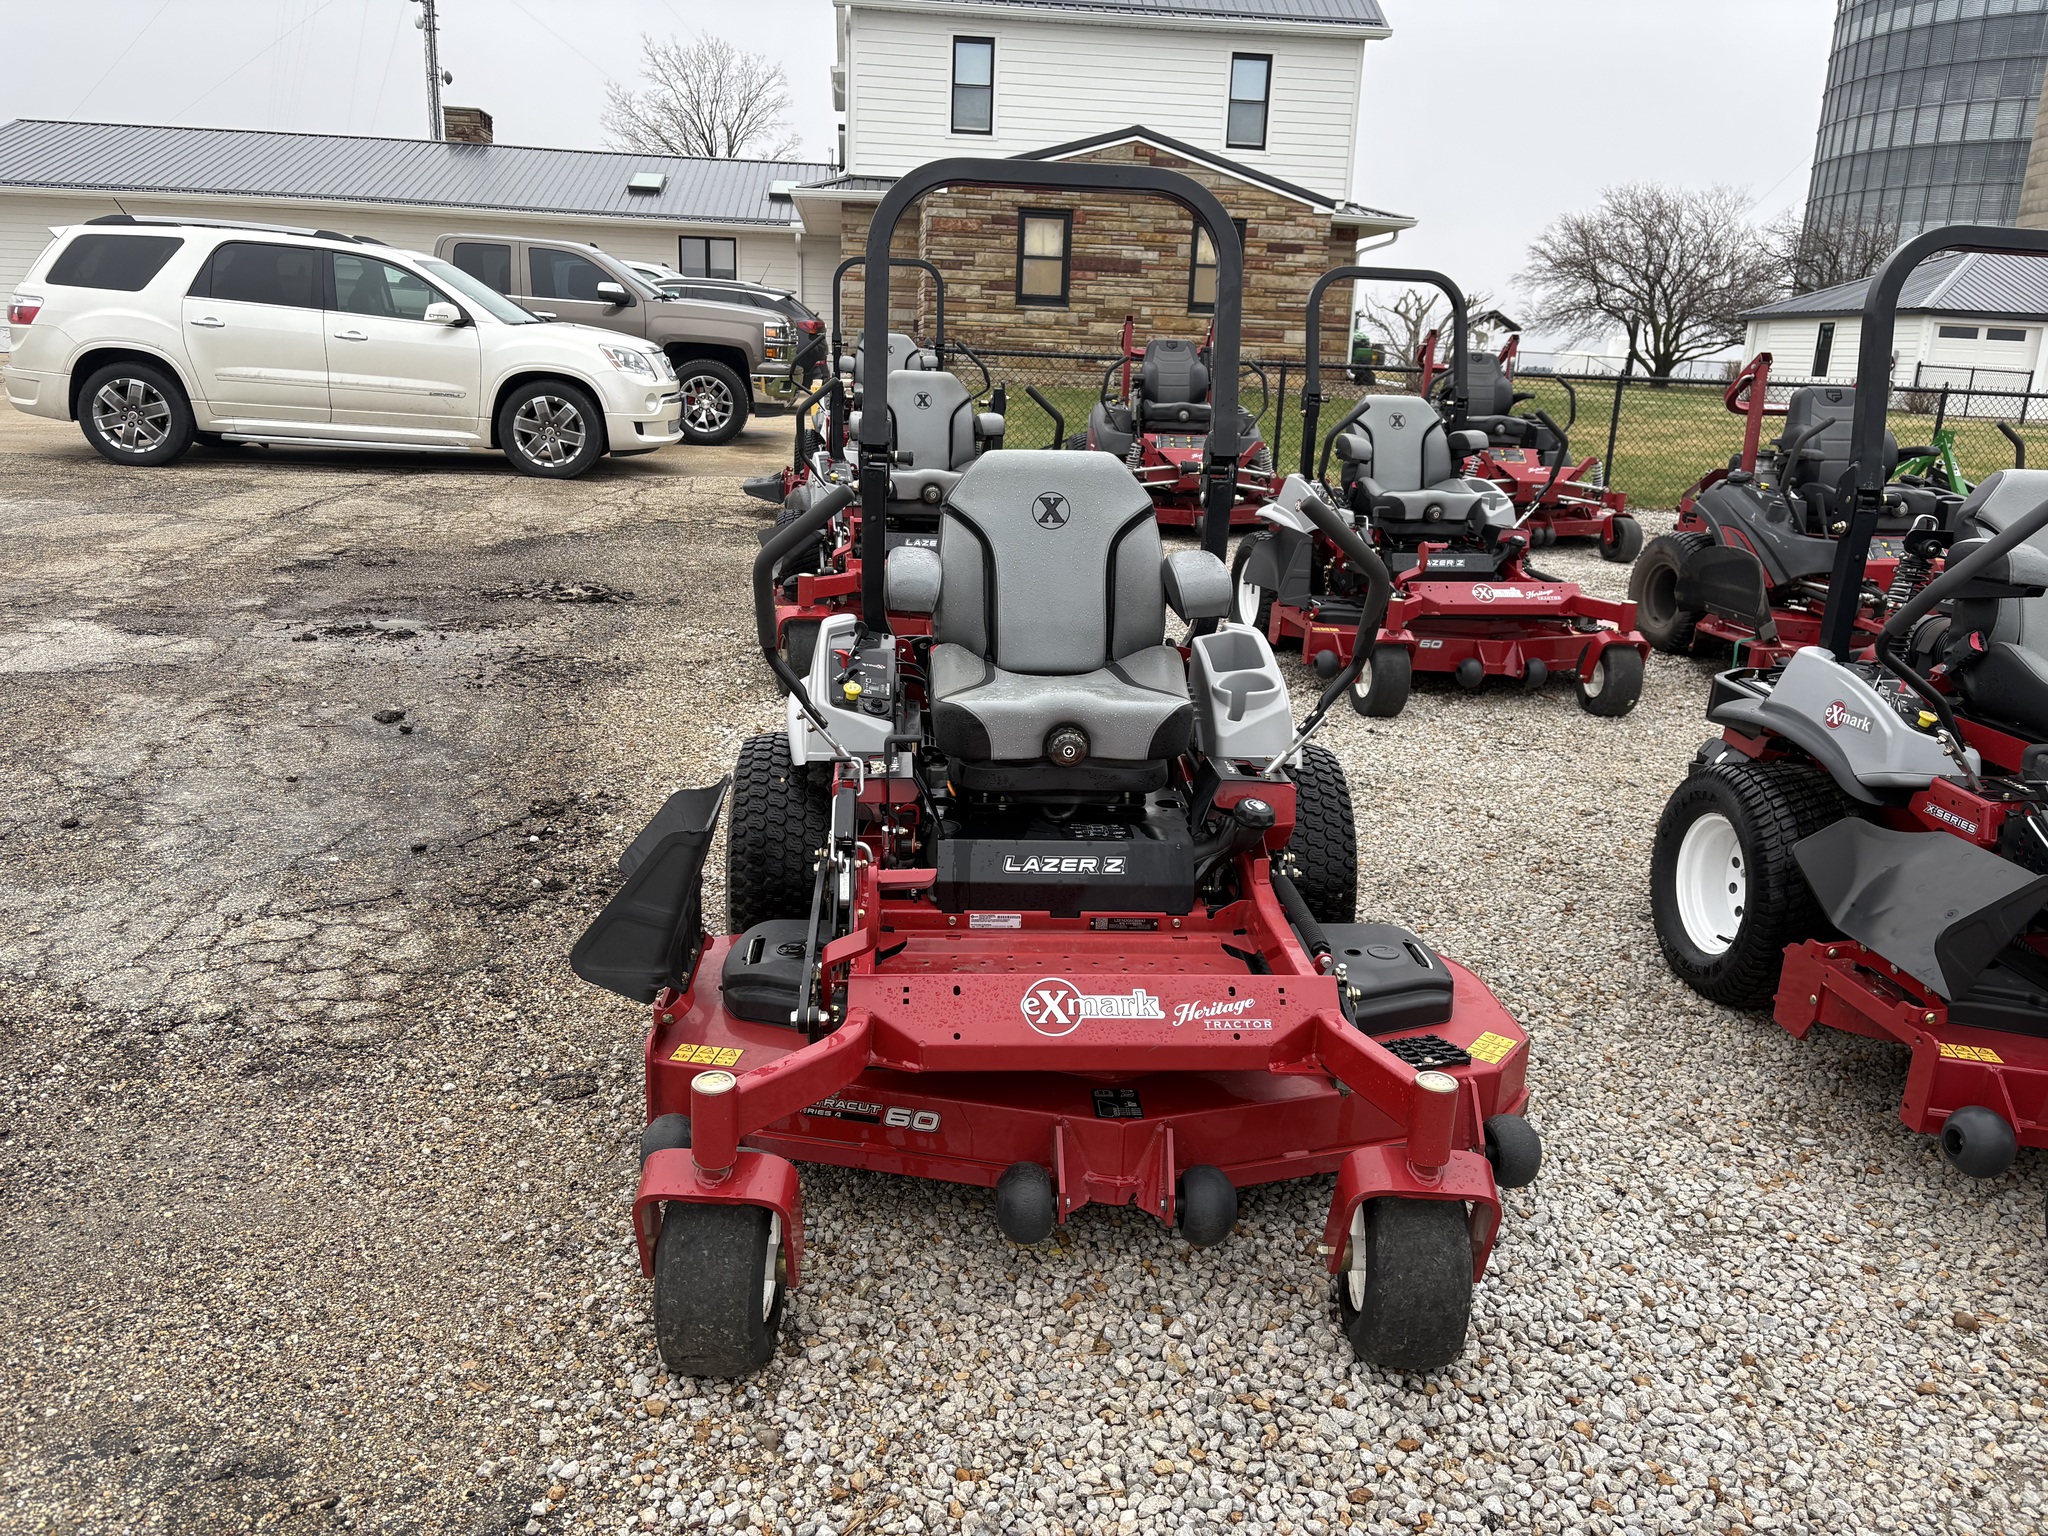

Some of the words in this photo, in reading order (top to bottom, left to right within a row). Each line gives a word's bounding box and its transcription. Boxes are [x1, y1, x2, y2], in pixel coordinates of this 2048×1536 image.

[916, 393, 931, 407] X
[1037, 495, 1066, 525] X
[905, 539, 938, 547] LAZE
[1456, 559, 1465, 567] Z
[1419, 639, 1443, 649] 60
[1004, 857, 1098, 873] LAZER
[1104, 857, 1124, 873] Z
[1173, 998, 1256, 1026] Heritage
[1205, 1020, 1272, 1029] TRACTOR
[801, 1107, 832, 1116] ERIES
[816, 1098, 882, 1114] RACUT
[885, 1107, 940, 1131] 60
